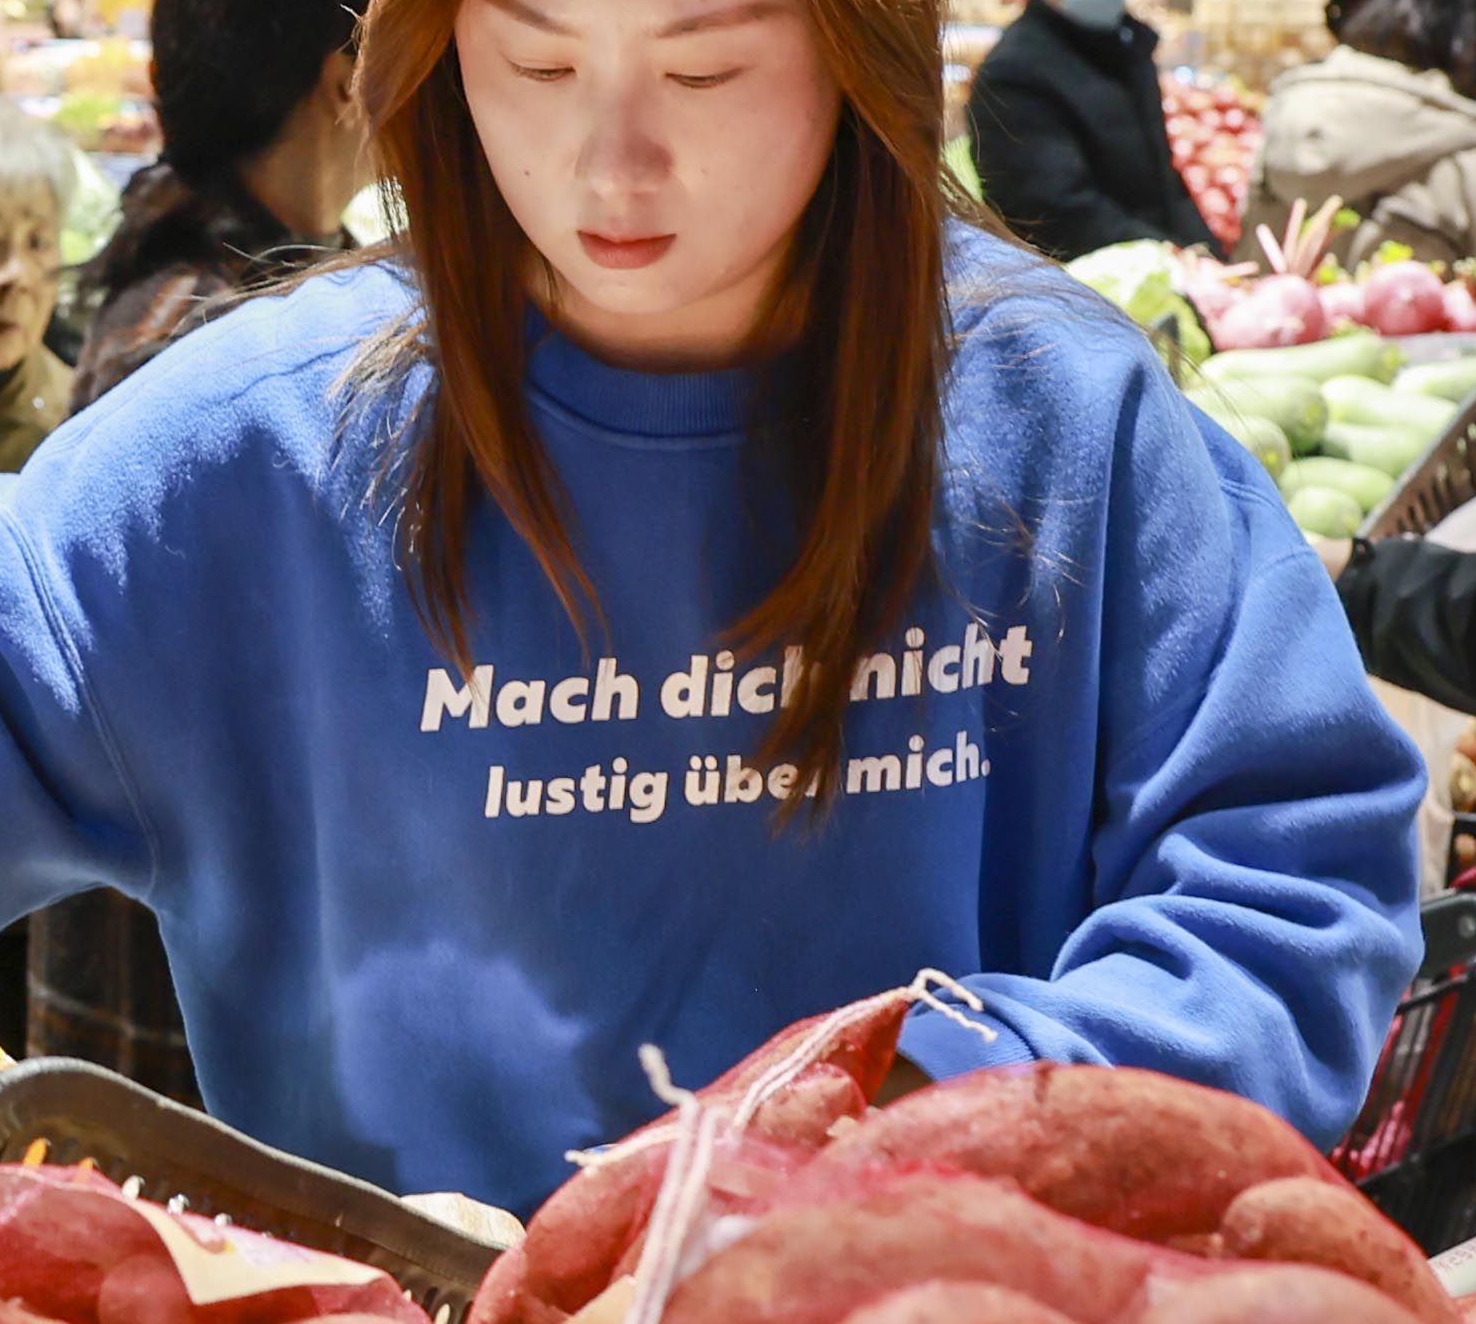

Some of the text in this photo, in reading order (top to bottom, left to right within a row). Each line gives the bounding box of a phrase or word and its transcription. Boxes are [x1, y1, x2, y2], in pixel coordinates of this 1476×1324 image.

[419, 656, 640, 732] Mach
[850, 623, 1033, 702] nicht
[484, 757, 668, 824] lustig
[846, 730, 992, 794] mich.
